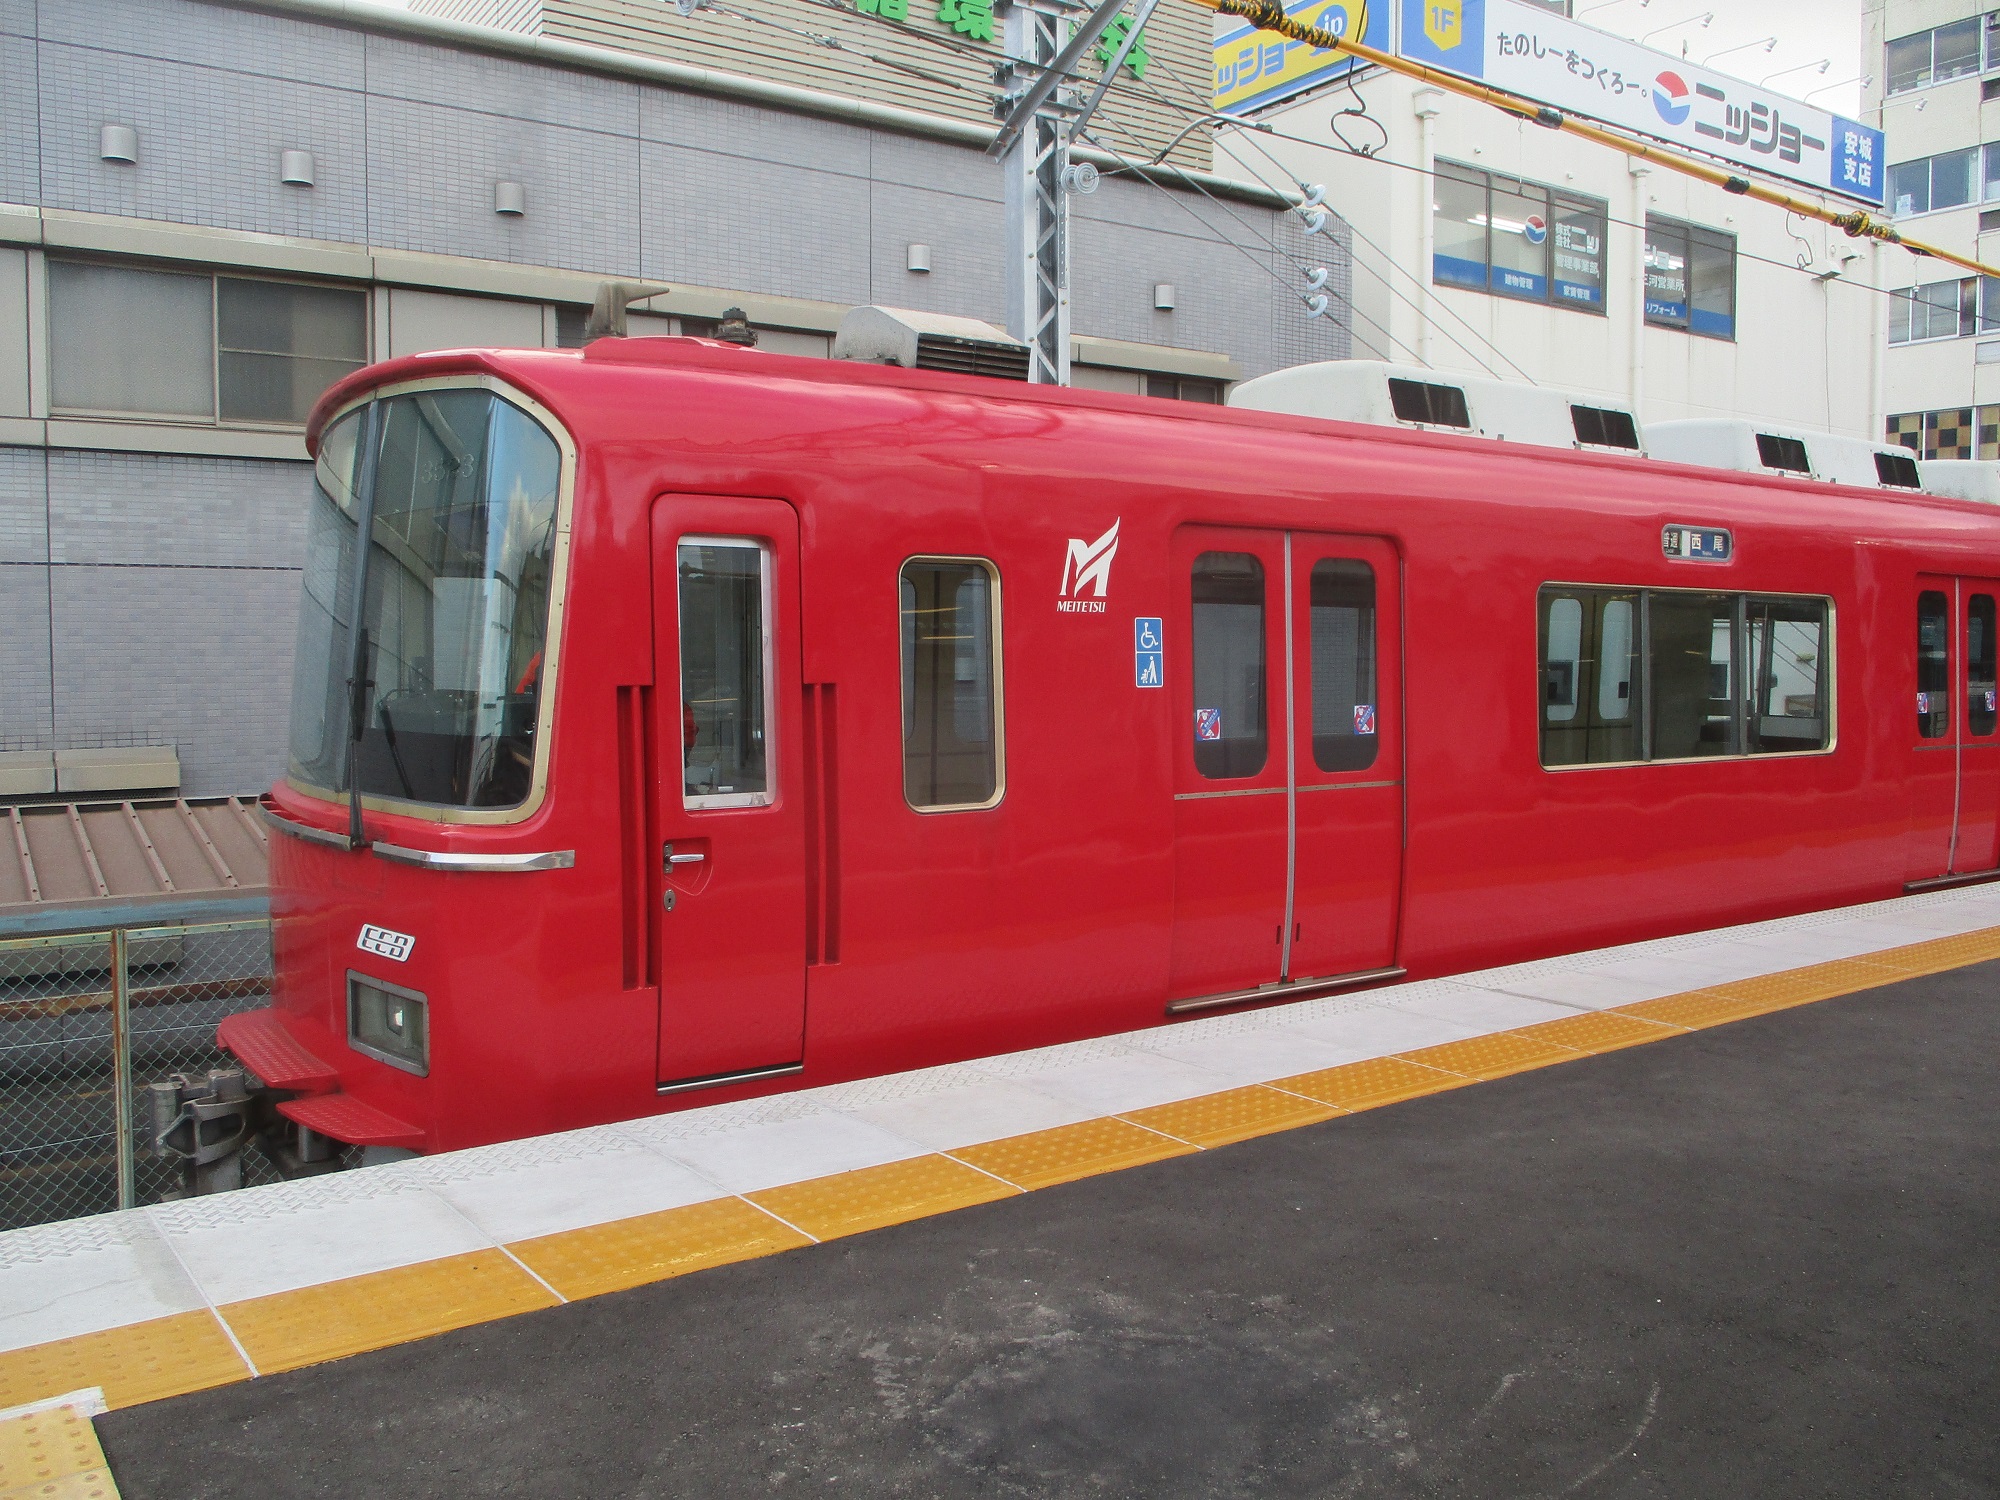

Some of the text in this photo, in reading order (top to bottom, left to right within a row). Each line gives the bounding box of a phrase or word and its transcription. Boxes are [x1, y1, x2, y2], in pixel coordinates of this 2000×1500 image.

[1431, 6, 1455, 33] 1F
[1214, 42, 1302, 95] ッショー
[1694, 82, 1825, 164] ニッショー
[1646, 303, 1677, 316] リフォーム
[1056, 600, 1107, 613] MEITETSU
